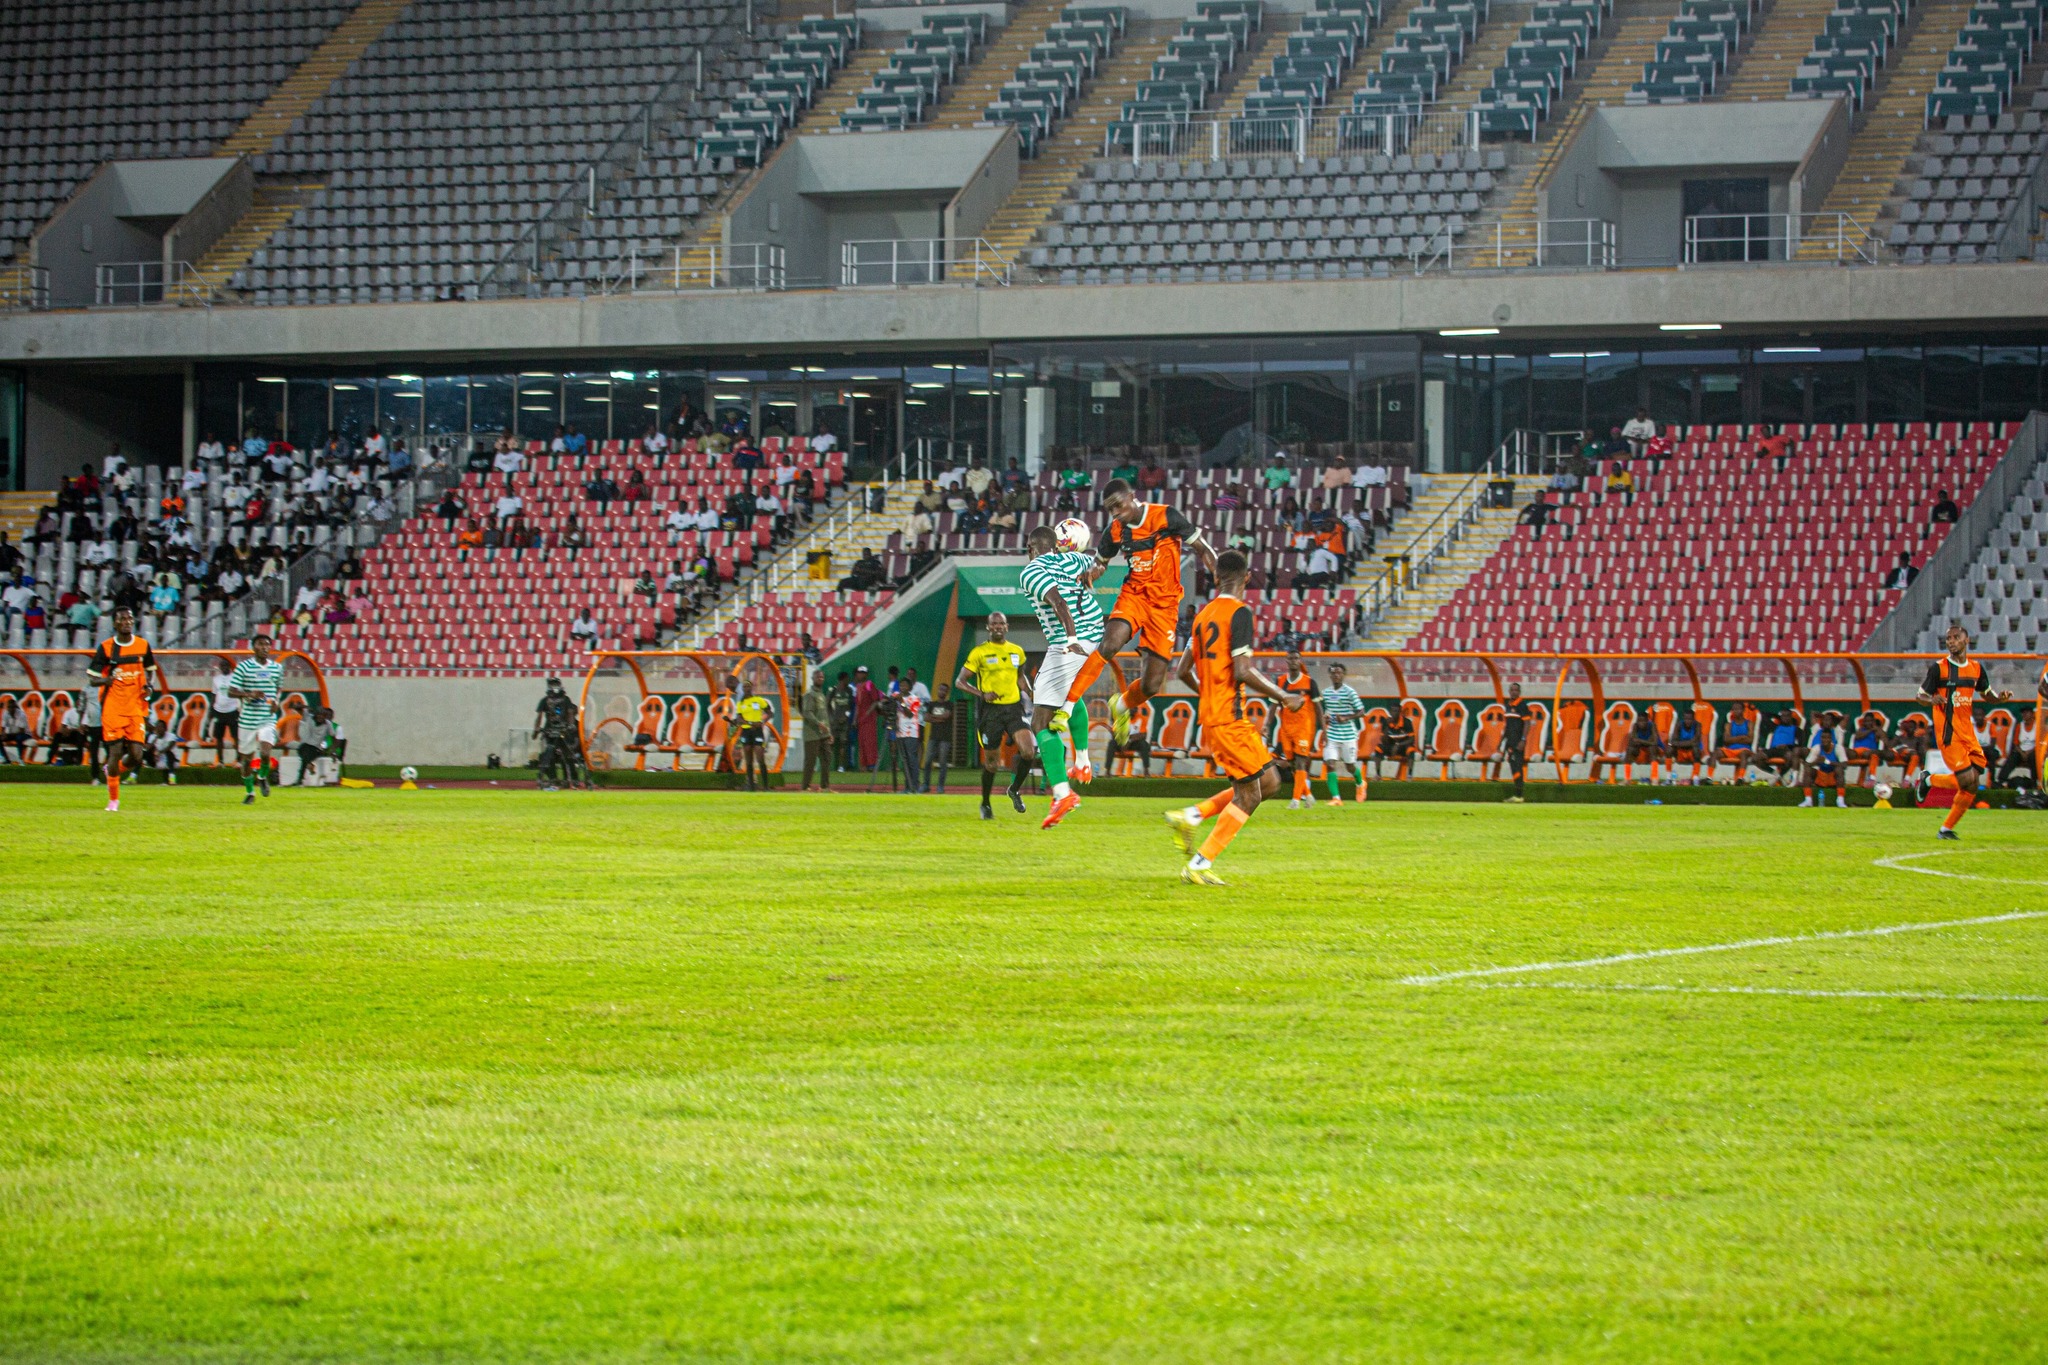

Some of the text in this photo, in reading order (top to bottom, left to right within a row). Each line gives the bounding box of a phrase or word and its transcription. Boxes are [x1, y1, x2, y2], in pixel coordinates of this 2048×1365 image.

[991, 586, 1012, 594] CAF
[1069, 589, 1085, 616] 7
[1195, 621, 1220, 659] 12
